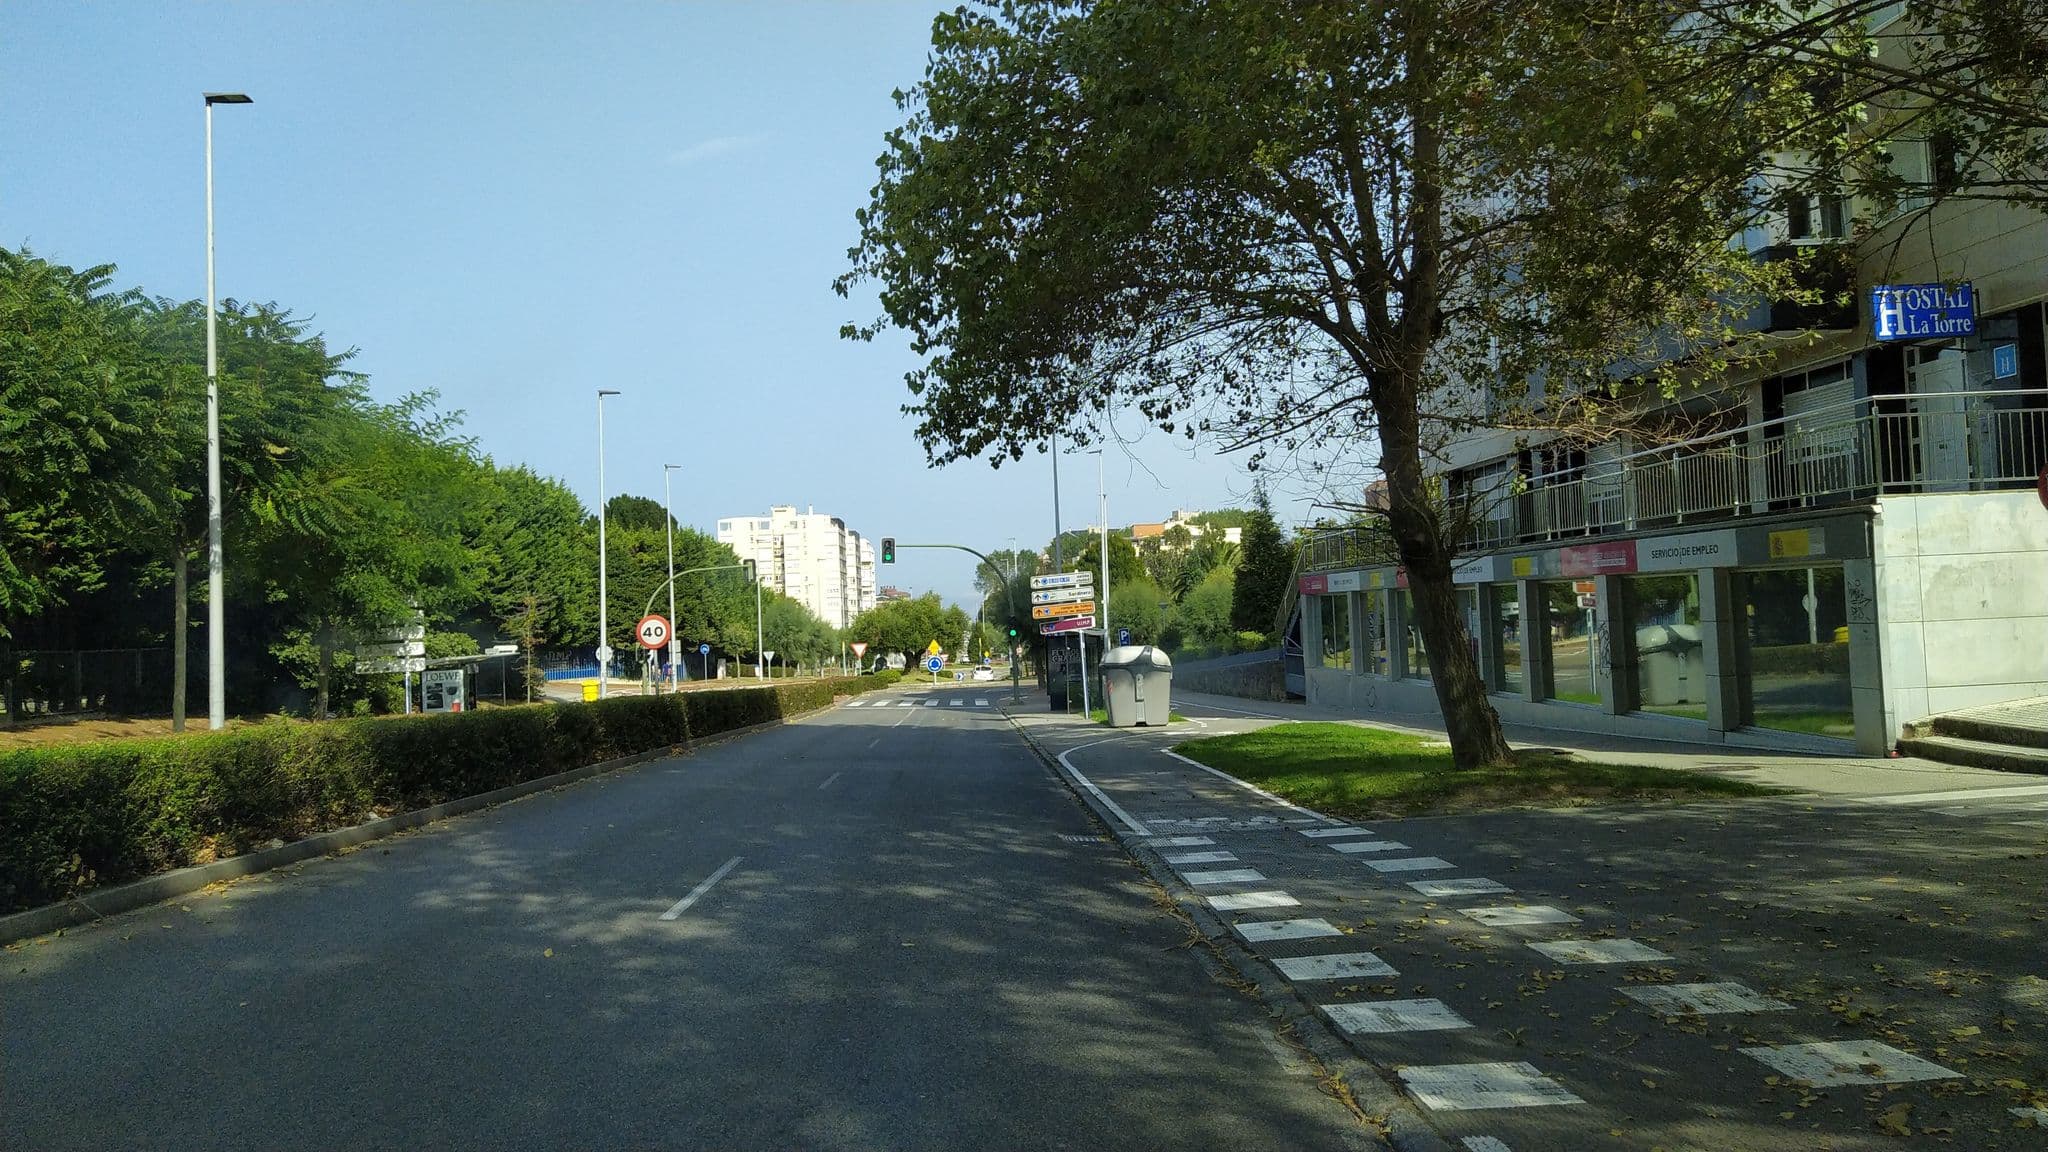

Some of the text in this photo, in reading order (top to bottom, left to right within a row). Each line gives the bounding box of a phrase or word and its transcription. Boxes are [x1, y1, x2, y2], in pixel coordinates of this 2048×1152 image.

[1876, 287, 1969, 336] HOSTAL
[1909, 312, 1971, 335] La Torre
[1651, 544, 1719, 559] SERVICIO DE EMPLEO
[642, 626, 664, 638] 40
[1121, 630, 1128, 641] P
[426, 671, 461, 682] LOEWE
